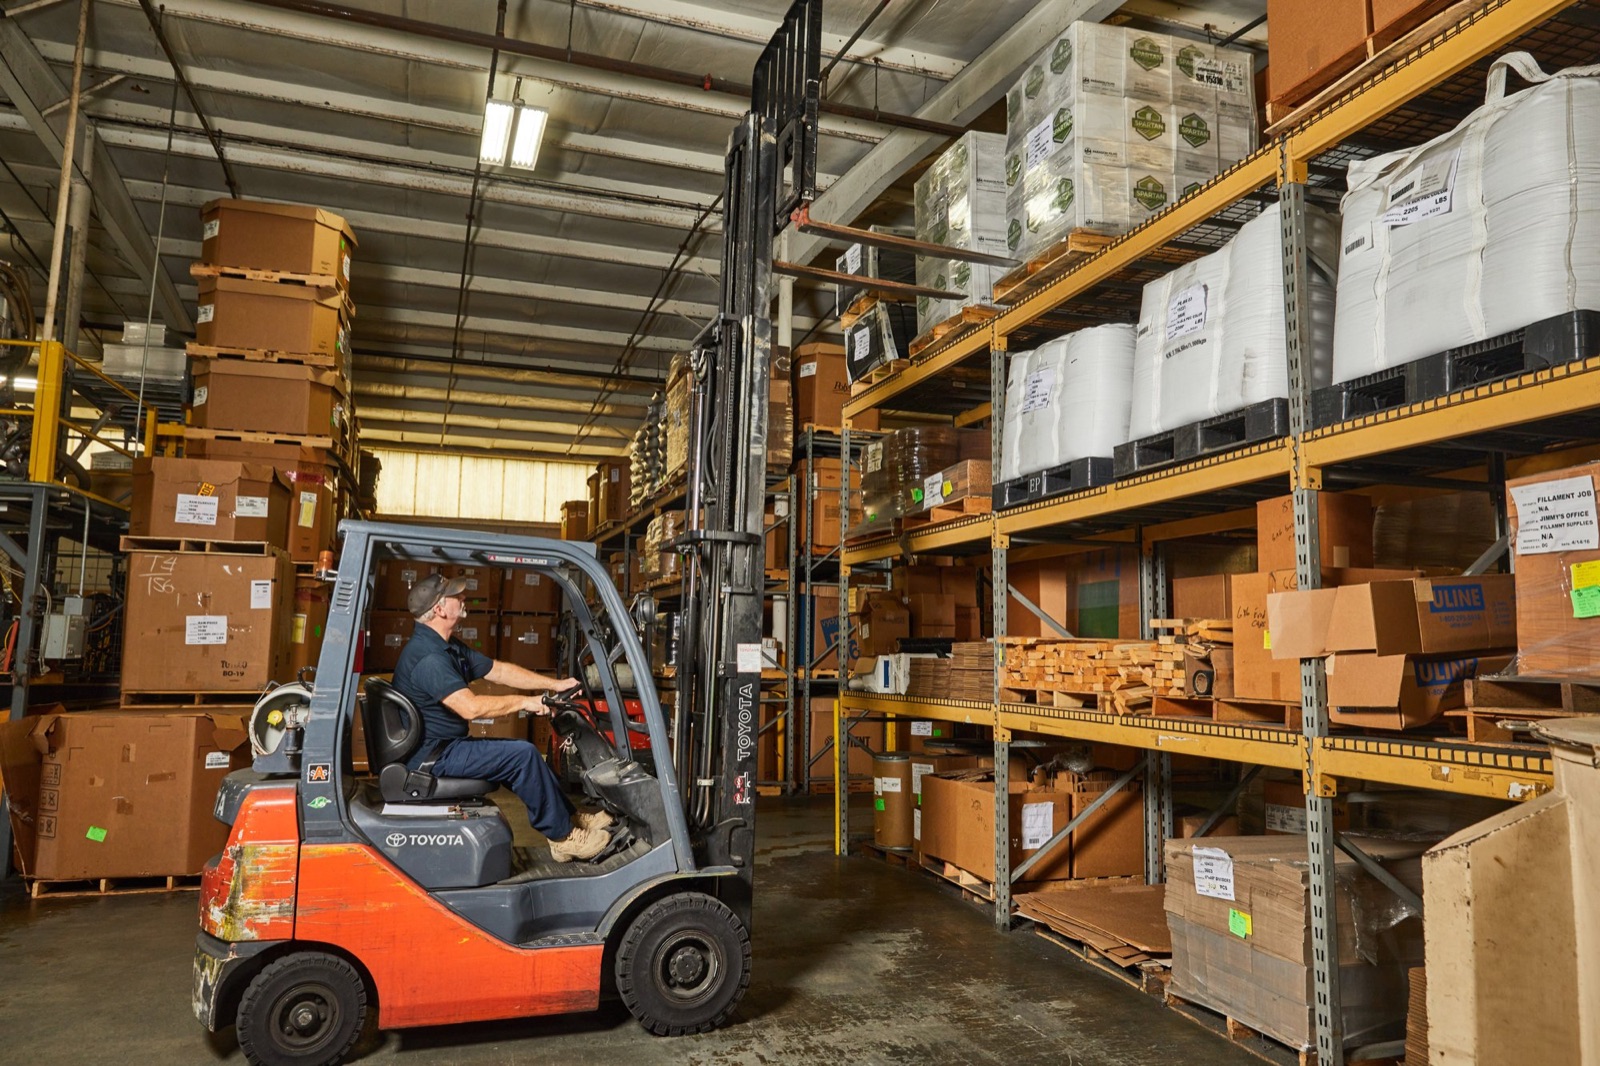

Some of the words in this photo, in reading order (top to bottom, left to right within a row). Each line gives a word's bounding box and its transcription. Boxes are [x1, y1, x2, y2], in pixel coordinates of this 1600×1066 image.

[1133, 49, 1161, 60] SPARTAN
[1134, 120, 1164, 130] SPARTAN
[1180, 126, 1209, 138] SPARTAN
[1136, 190, 1166, 200] SPARTAN
[1434, 195, 1448, 206] LBS
[1030, 477, 1040, 494] EP
[1537, 492, 1574, 504] FILLAMENT
[1577, 490, 1592, 498] JOB
[1540, 513, 1564, 522] JIMMY'S
[1566, 510, 1589, 518] OFFICE
[1540, 522, 1564, 530] FILLAMNT
[1433, 588, 1481, 609] ULINE
[1418, 659, 1477, 683] ULINE
[737, 683, 752, 762] TOYOTA
[409, 834, 464, 846] TOYOTA
